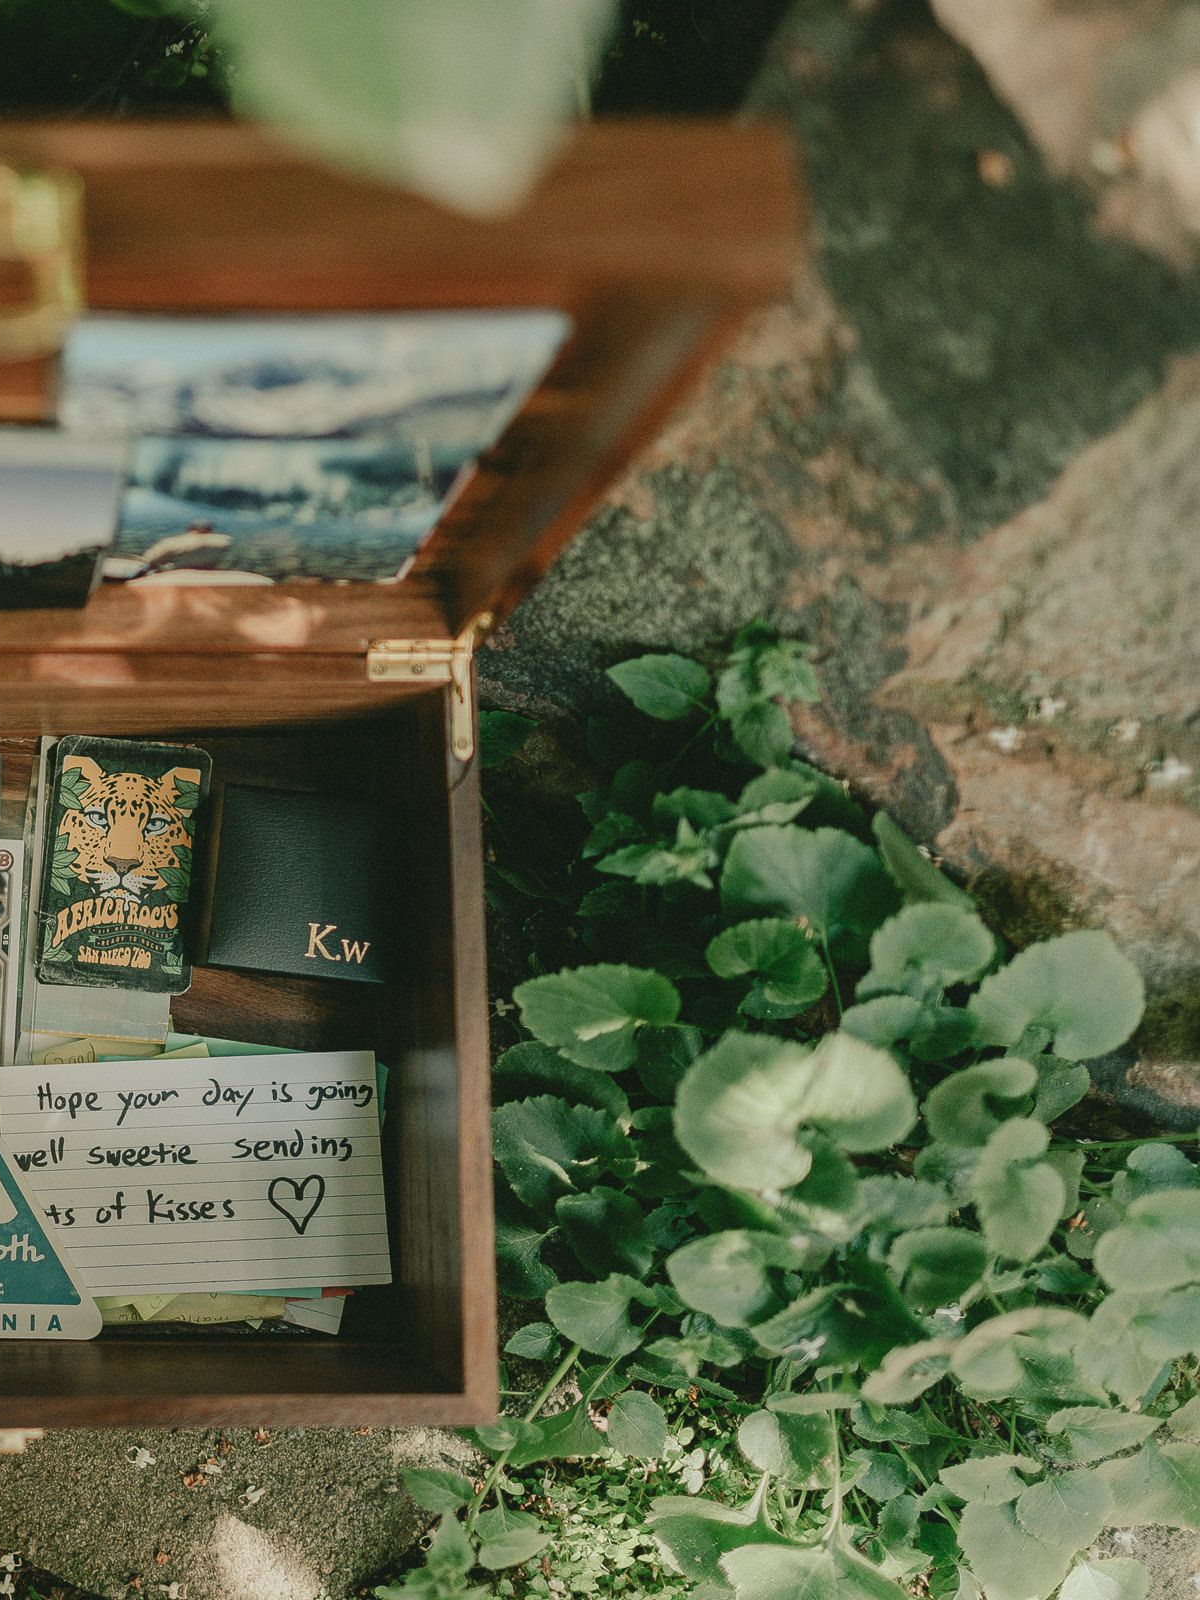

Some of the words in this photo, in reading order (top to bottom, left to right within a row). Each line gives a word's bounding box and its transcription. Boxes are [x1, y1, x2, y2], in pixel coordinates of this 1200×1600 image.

[52, 896, 125, 949] AFRICA
[127, 900, 179, 930] ROCKS
[77, 945, 101, 965] SAN
[100, 946, 131, 967] DIEGO
[131, 946, 152, 969] ZOO
[101, 936, 125, 947] READY
[129, 935, 138, 943] TO
[141, 939, 160, 951] ROCK
[37, 1082, 103, 1119] Hope
[116, 1089, 179, 1126] your
[202, 1078, 255, 1117] day
[271, 1081, 293, 1103] is
[305, 1080, 374, 1111] going
[13, 1136, 65, 1172] well
[86, 1142, 199, 1167] sweetie
[231, 1128, 353, 1162] sending
[96, 1191, 127, 1224] of
